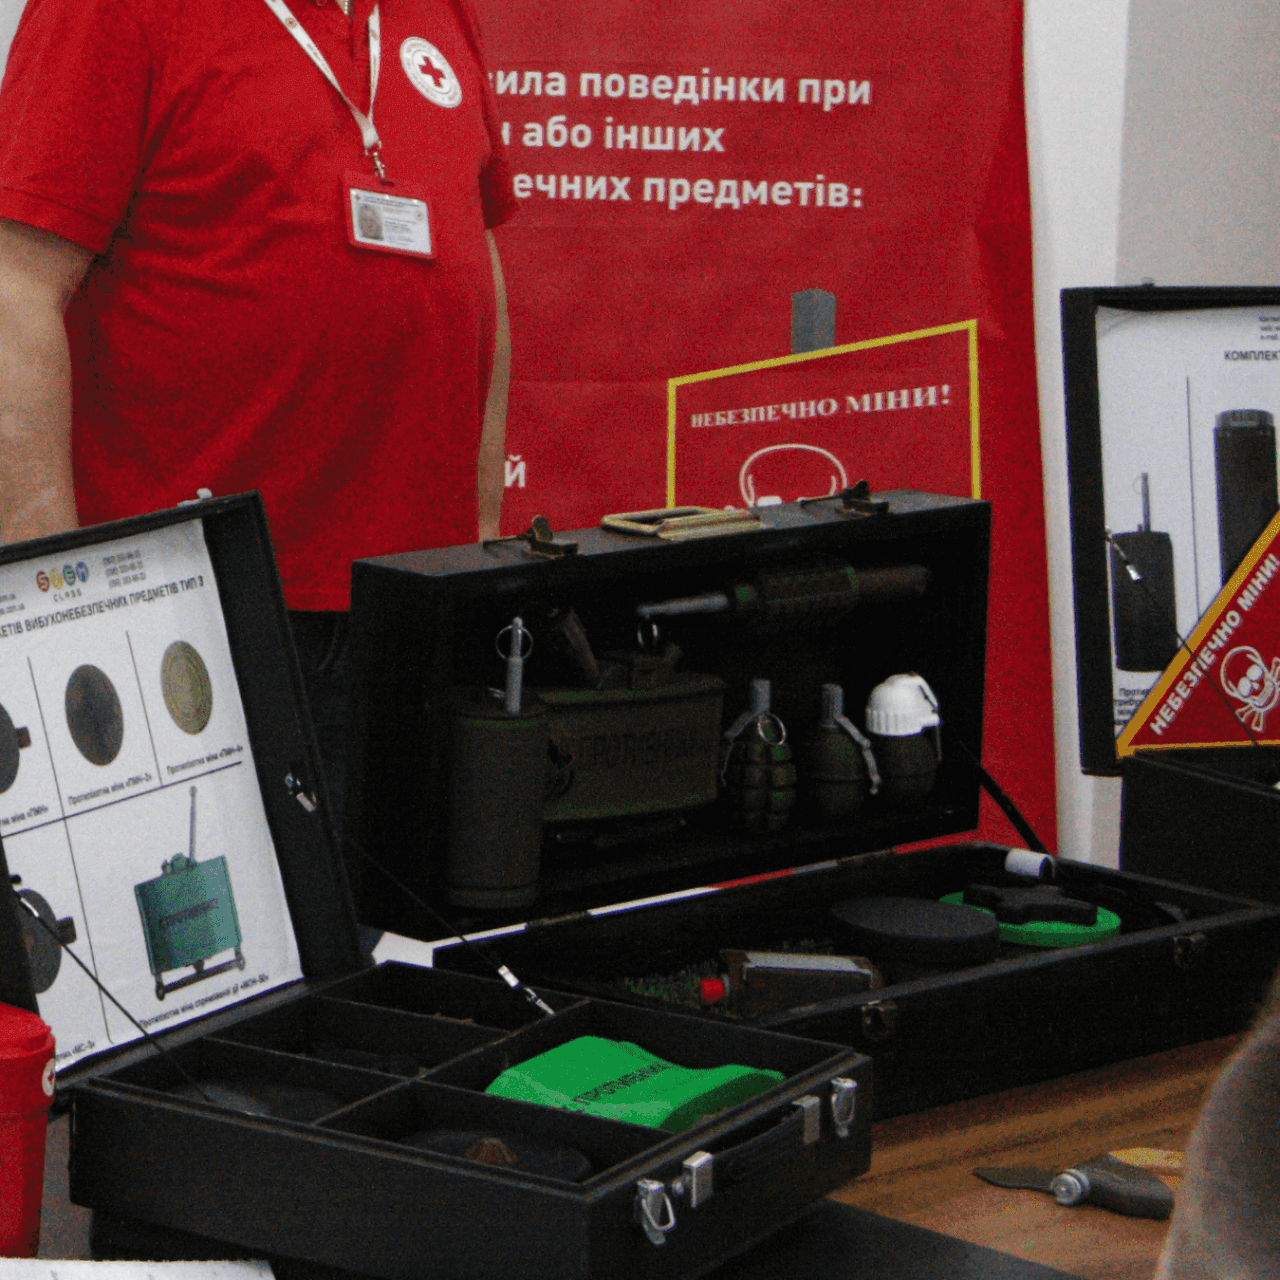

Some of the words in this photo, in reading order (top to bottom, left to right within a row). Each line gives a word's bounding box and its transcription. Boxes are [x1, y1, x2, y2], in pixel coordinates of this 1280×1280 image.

[488, 70, 566, 97] ила
[579, 67, 785, 106] поведінки
[798, 78, 871, 112] при
[522, 114, 592, 148] або
[605, 116, 726, 152] інших
[643, 174, 863, 211] предметів:
[1224, 350, 1280, 361] КОМПЛЕК
[690, 398, 838, 428] НЕБЕЗПЕЧНО
[845, 384, 951, 415] МІНИ!
[24, 598, 129, 633] ВИБУХОНЕБЕЗПЕЧНИХ
[129, 582, 179, 605] ПРЕДМЕТІВ
[180, 577, 198, 592] ТИП
[1149, 609, 1242, 736] НЕБЕЗПЕЧНО
[1236, 552, 1280, 612] МІНИ!
